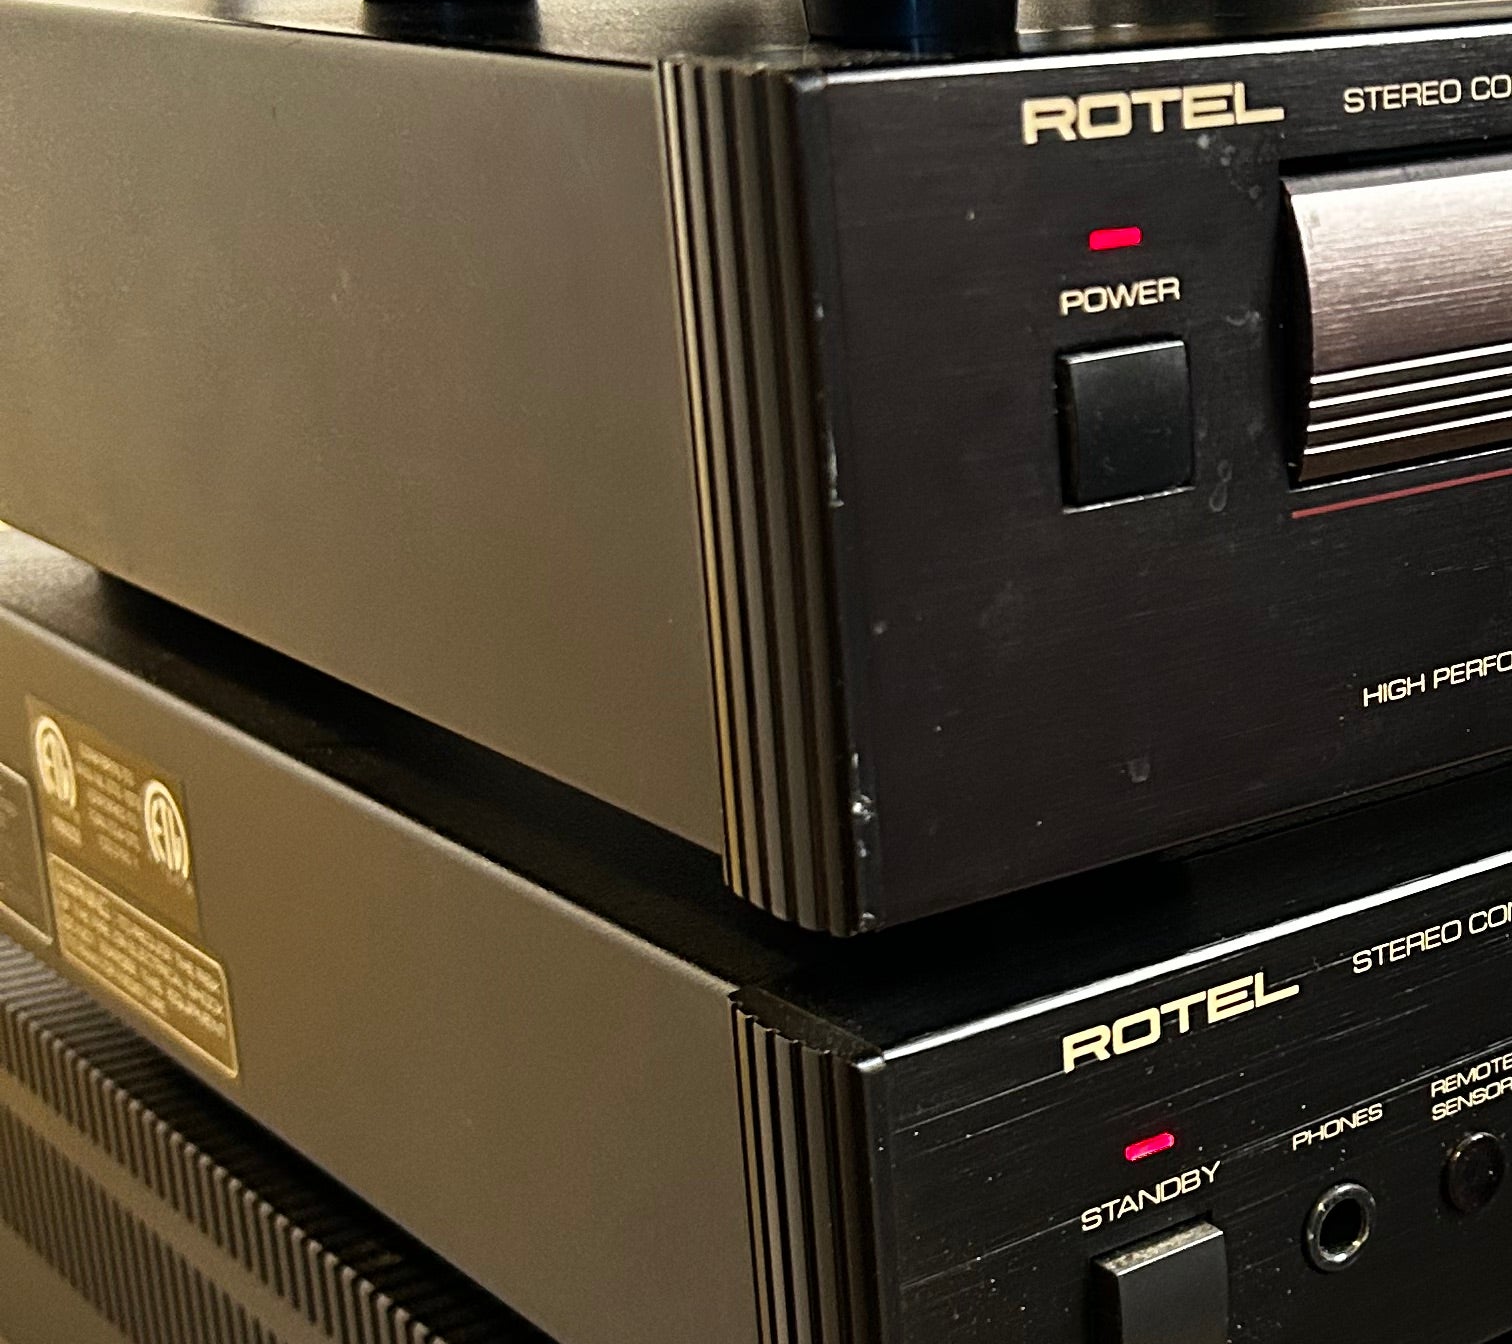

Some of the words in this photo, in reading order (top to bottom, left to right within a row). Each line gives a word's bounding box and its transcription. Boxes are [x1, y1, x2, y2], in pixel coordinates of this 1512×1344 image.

[1022, 81, 1285, 145] ROTEL
[1343, 79, 1462, 114] STEREO
[1060, 277, 1180, 316] POWER
[1362, 673, 1425, 706] HIGH
[1352, 919, 1462, 974] STEREO
[1063, 972, 1299, 1073] ROTEL
[1292, 1103, 1382, 1150] PHONES
[1081, 1161, 1220, 1231] STANDBY
